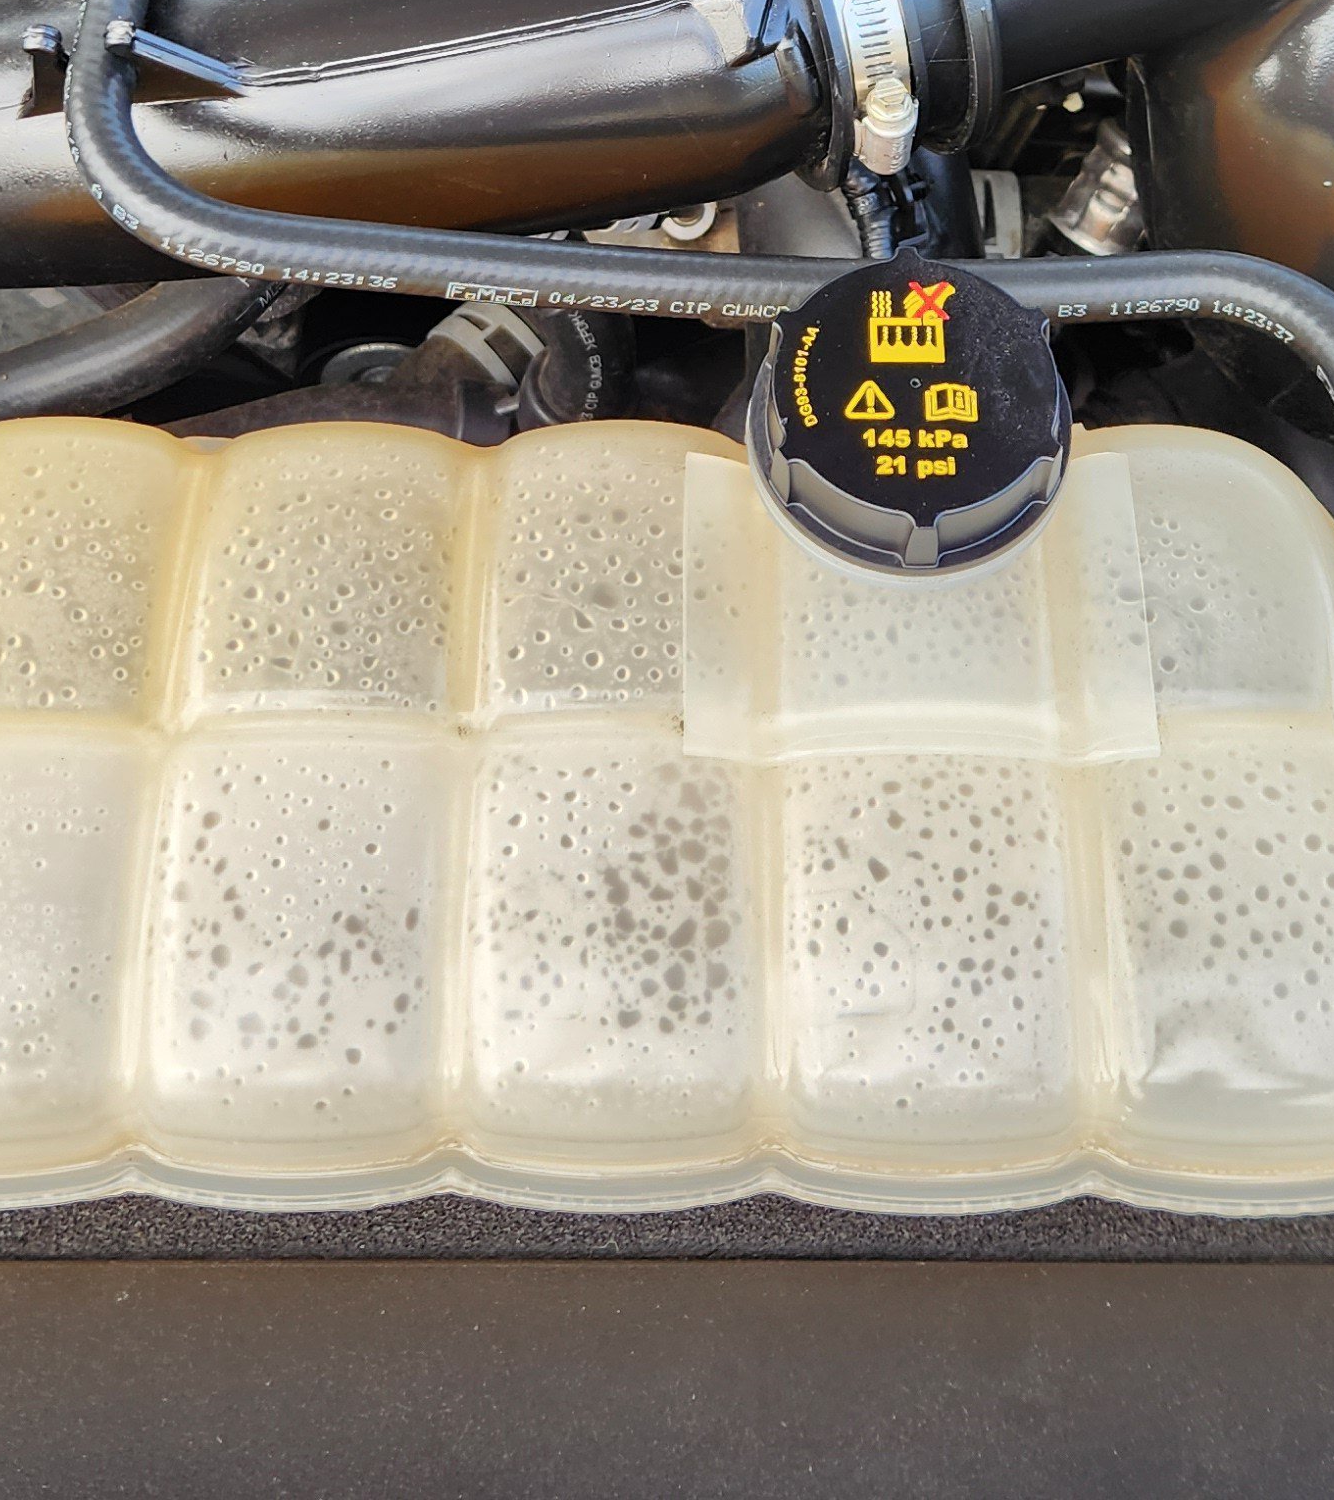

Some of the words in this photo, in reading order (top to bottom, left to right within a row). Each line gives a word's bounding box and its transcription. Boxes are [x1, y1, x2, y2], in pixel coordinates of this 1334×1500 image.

[160, 236, 265, 275] 1126790
[282, 267, 398, 290] 14:23:36
[447, 283, 537, 307] FoMoCo
[548, 291, 660, 312] 04/23/23
[669, 301, 711, 316] CIP
[1109, 298, 1200, 317] 1126790
[862, 428, 910, 448] 145
[917, 428, 968, 449] kPa
[875, 456, 907, 476] 21
[917, 456, 957, 479] psi
